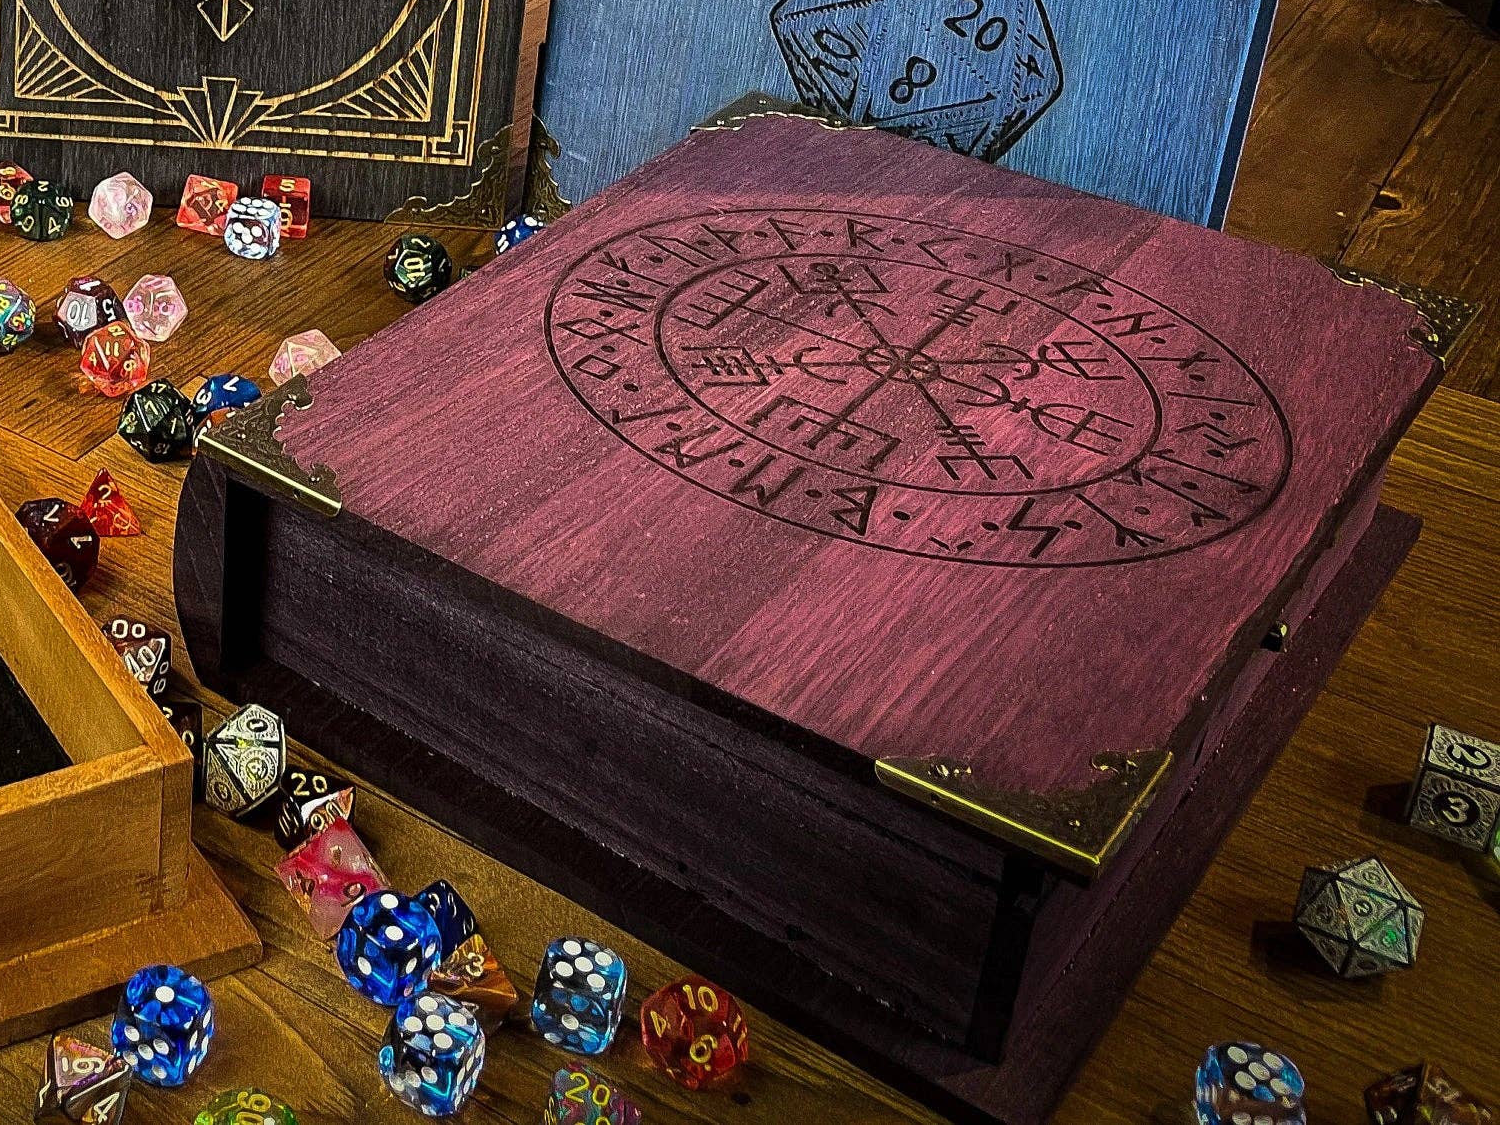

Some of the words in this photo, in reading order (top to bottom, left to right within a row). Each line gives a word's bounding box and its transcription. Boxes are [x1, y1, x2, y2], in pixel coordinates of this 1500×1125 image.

[888, 55, 938, 105] 8
[278, 178, 296, 192] 5
[403, 257, 426, 281] 10
[66, 300, 89, 322] 10
[102, 298, 117, 322] 5
[105, 340, 120, 357] 11
[98, 484, 112, 504] 2
[124, 645, 156, 682] 40
[1452, 744, 1488, 766] 2
[291, 772, 328, 796] 20
[1442, 796, 1470, 823] 3
[465, 952, 485, 977] 3
[682, 984, 718, 1012] 10
[650, 1010, 672, 1038] 4
[565, 1072, 611, 1107] 20
[94, 1091, 120, 1124] 4
